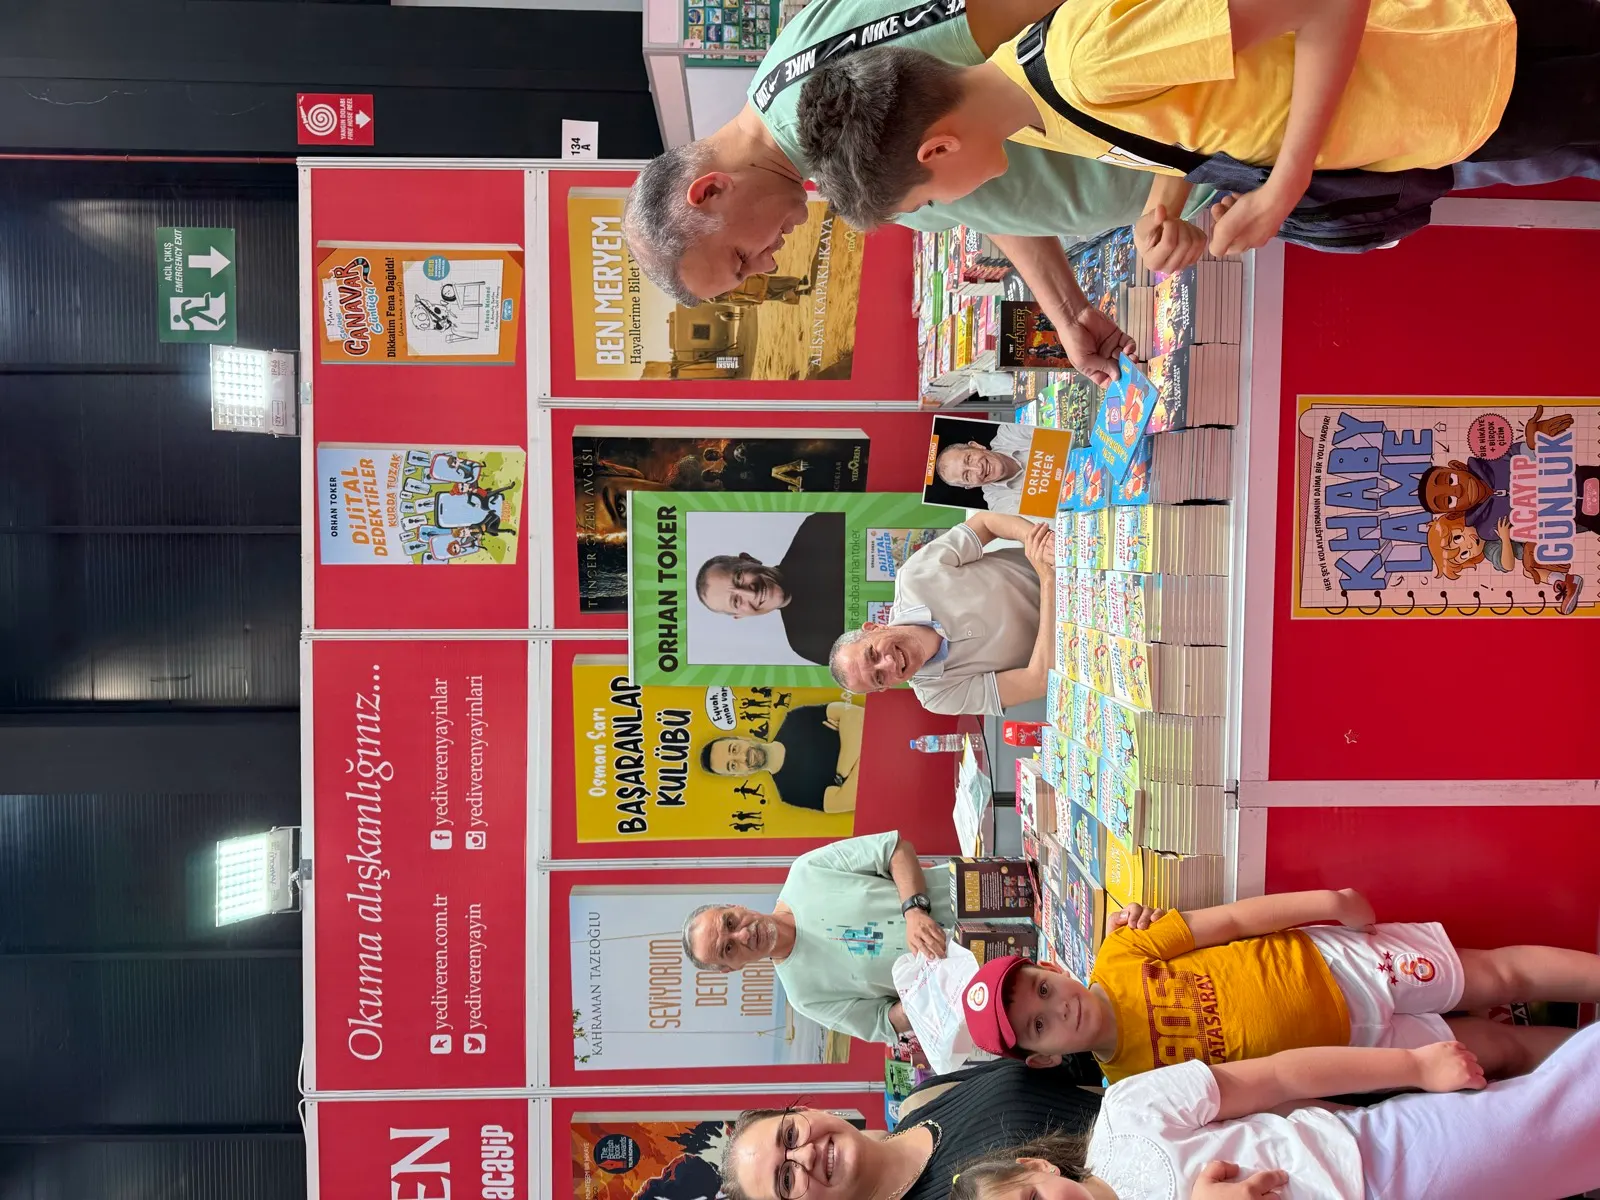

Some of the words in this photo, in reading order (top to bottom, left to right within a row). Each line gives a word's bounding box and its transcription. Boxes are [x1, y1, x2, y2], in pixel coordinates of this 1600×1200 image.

[861, 16, 900, 45] NIKE
[784, 48, 817, 81] NIKE
[571, 138, 580, 156] 134
[163, 242, 174, 262] ÇIKIŞ
[174, 228, 182, 246] EXIT
[174, 247, 184, 293] EMERGENCY
[385, 257, 396, 292] Dağıldı!
[590, 216, 624, 314] MERYEM
[628, 267, 641, 294] Bilet
[813, 217, 833, 314] KAPAKLIKAYA
[333, 258, 371, 355] CANAVAR
[386, 295, 396, 317] Fena
[387, 320, 396, 358] Dikkatim
[595, 321, 624, 366] BEN
[630, 296, 644, 364] Hayallerime
[1316, 443, 1326, 460] YOLU
[1319, 415, 1332, 442] VARDIR!
[329, 476, 338, 505] TOKER
[386, 454, 401, 489] TUZAK
[1028, 450, 1044, 496] ORHAN
[1038, 454, 1055, 494] TOKER
[386, 492, 398, 528] KURDA
[1325, 412, 1387, 591] KHABY
[1380, 428, 1433, 572] LAME
[1536, 430, 1574, 562] GÜNLÜK
[330, 508, 338, 537] ORHAN
[656, 505, 678, 583] TOKER
[1313, 498, 1326, 562] KOLAYLAŞTIRMANIN
[1323, 578, 1332, 591] HER
[658, 590, 678, 672] ORHAN
[586, 707, 607, 740] Sarı
[710, 692, 724, 722] Eyvah,
[430, 678, 454, 826] yediverenyayinlar
[465, 674, 488, 827] yediverenyayinlari
[588, 744, 607, 797] Osman
[654, 708, 692, 806] KULÜBÜ
[345, 663, 394, 923] alışkanlığınız...
[431, 894, 454, 1030] yediveren.com.tr
[464, 902, 488, 1030] yediverenyayin
[586, 911, 602, 980] TAZEOĞLU
[347, 932, 383, 1061] Okuma
[694, 971, 728, 1007] DEM
[590, 984, 603, 1056] KAHRAMAN
[480, 1124, 514, 1199] acayip
[600, 1147, 608, 1160] The
